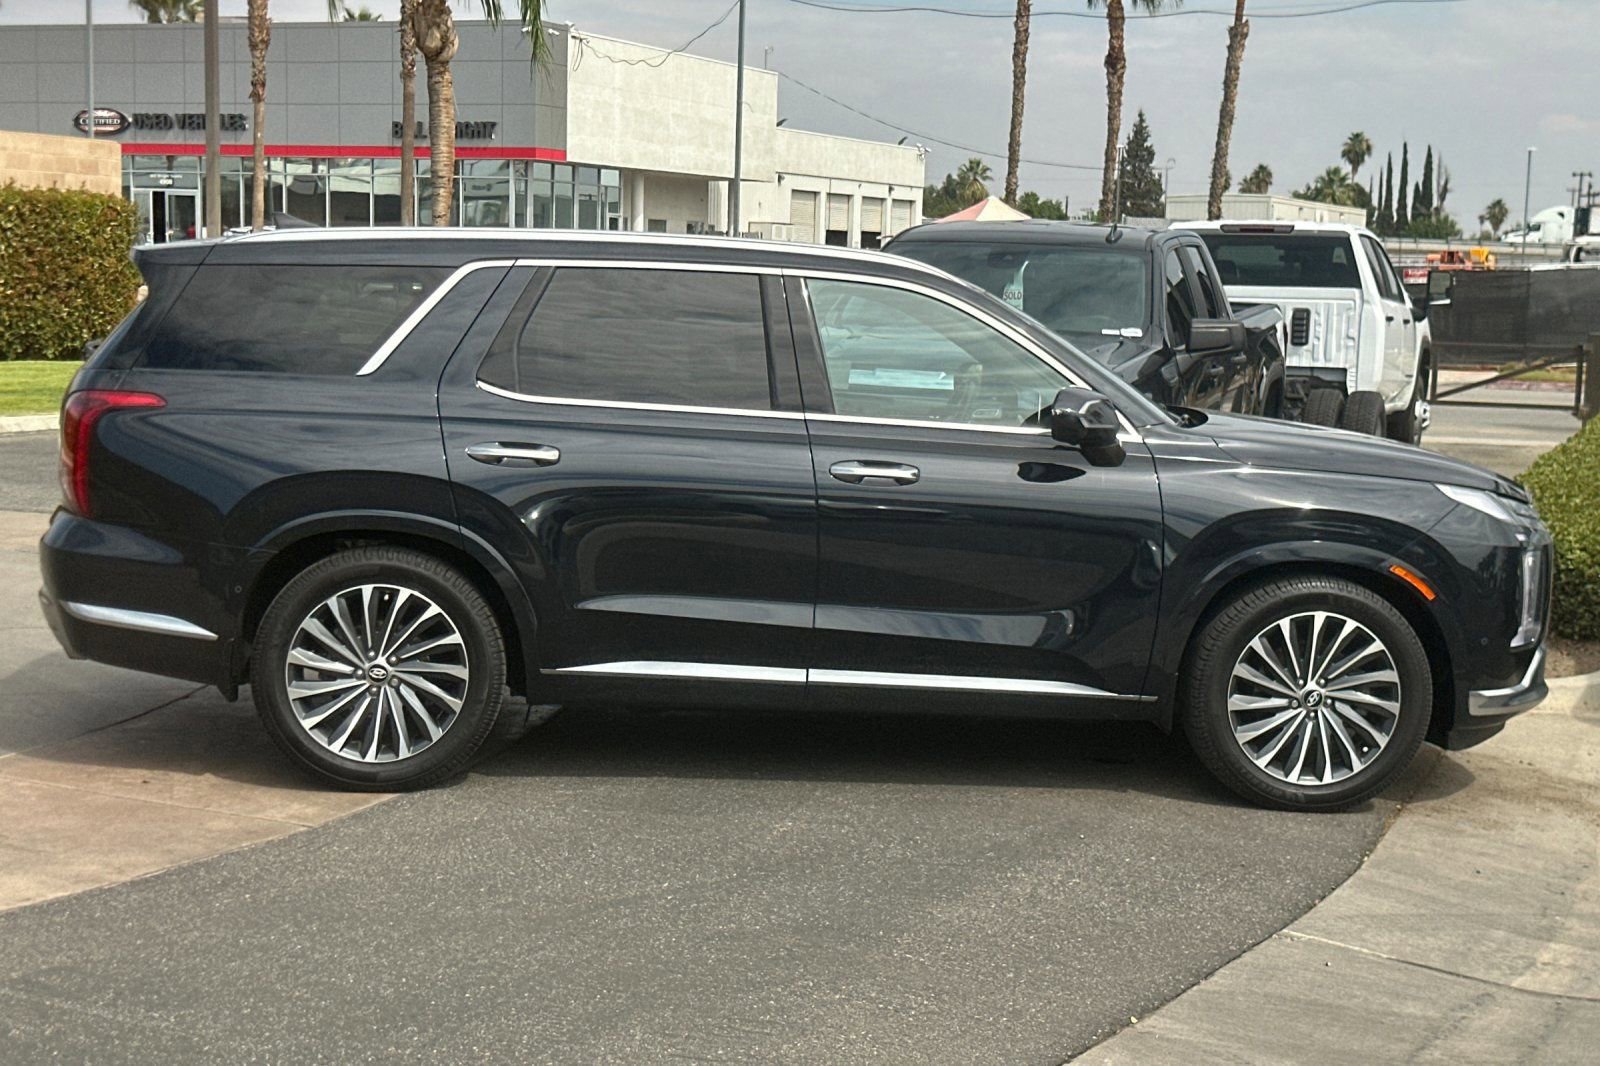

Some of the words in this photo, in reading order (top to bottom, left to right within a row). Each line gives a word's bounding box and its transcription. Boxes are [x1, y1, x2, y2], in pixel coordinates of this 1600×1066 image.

[132, 113, 173, 130] USED
[175, 113, 248, 131] VEHLES
[391, 121, 428, 139] BL
[1004, 291, 1023, 300] SOLD
